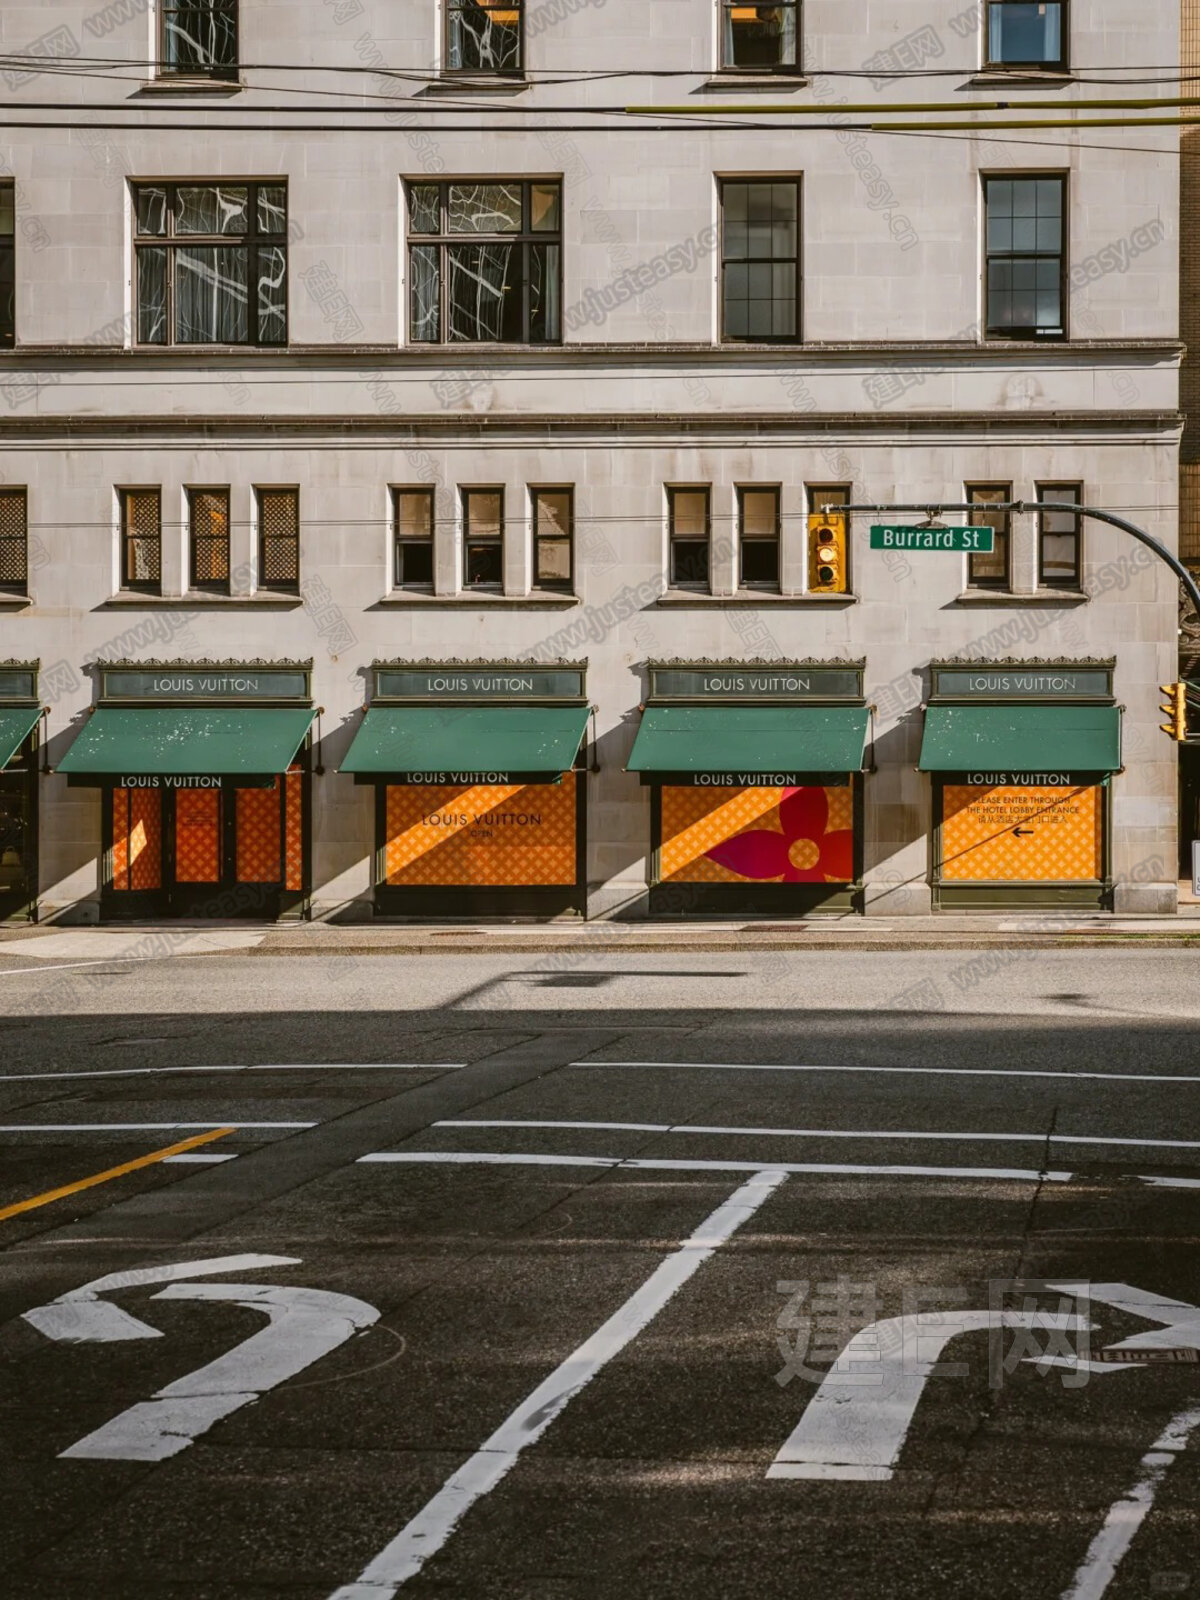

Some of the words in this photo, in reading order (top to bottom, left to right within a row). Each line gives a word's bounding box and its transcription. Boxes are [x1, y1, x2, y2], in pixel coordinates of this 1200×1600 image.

[883, 529, 953, 547] Burrard
[962, 530, 979, 548] St
[153, 679, 193, 692] LOUIS
[199, 679, 258, 692] VUITTON
[427, 678, 468, 691] LOUIS
[472, 678, 533, 691] VUITTON
[703, 678, 744, 691] LOUIS
[749, 678, 810, 691] VUITTON
[969, 677, 1009, 690] LOUIS
[1014, 677, 1076, 690] VUITTON
[121, 776, 159, 788] LOUIS
[164, 776, 222, 788] VUITTON
[407, 772, 446, 783] LOUIS
[450, 772, 509, 783] VUITTON
[694, 774, 733, 785] LOUIS
[738, 774, 796, 785] VUITTON
[967, 773, 1006, 785] LOUIS
[1011, 773, 1070, 785] VUITTON
[1003, 796, 1028, 804] ENTER
[1030, 796, 1071, 804] THROUGH
[966, 806, 980, 814] THE
[982, 806, 1007, 814] HOTEL
[1009, 806, 1034, 814] LOBBY
[1036, 806, 1080, 814] ENTRANCE
[421, 813, 468, 826] LOUIS
[473, 813, 542, 826] VUITTON
[470, 829, 493, 838] OPEN
